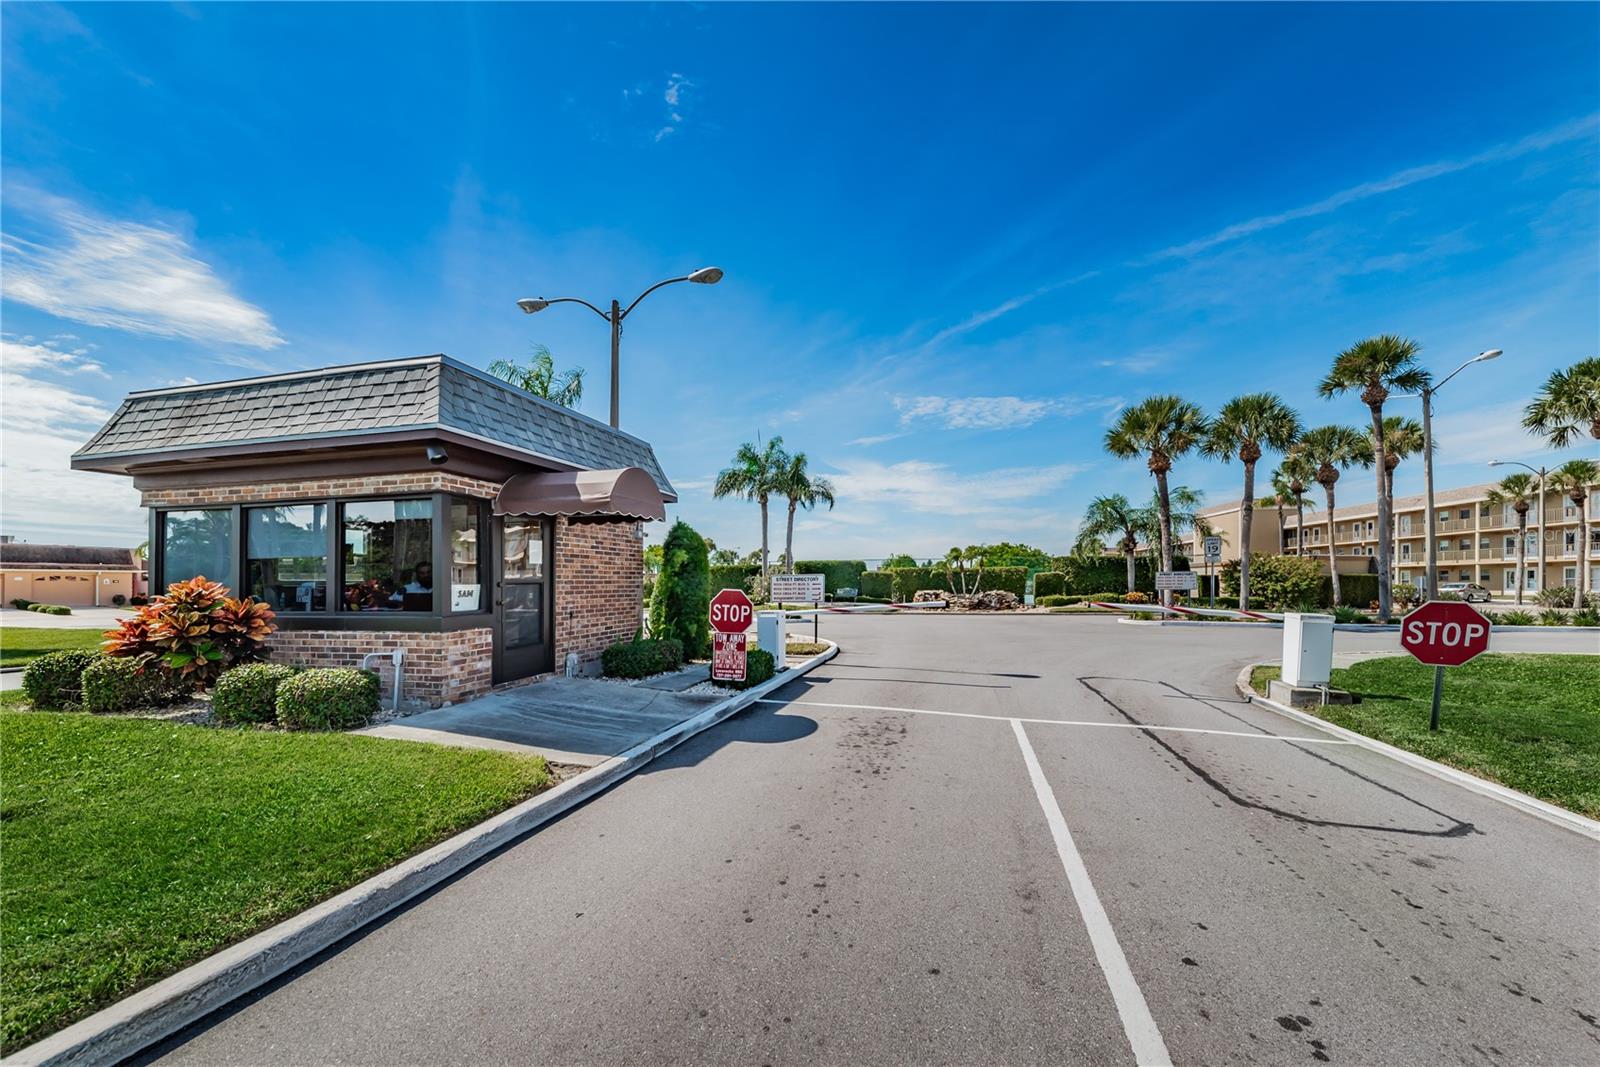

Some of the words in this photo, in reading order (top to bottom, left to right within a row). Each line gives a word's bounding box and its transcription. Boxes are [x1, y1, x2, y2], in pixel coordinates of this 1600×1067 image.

[712, 603, 750, 623] STOP
[716, 634, 727, 642] TOW
[730, 634, 744, 643] AWAY
[1406, 620, 1484, 647] STOP
[723, 641, 738, 651] ZONE
